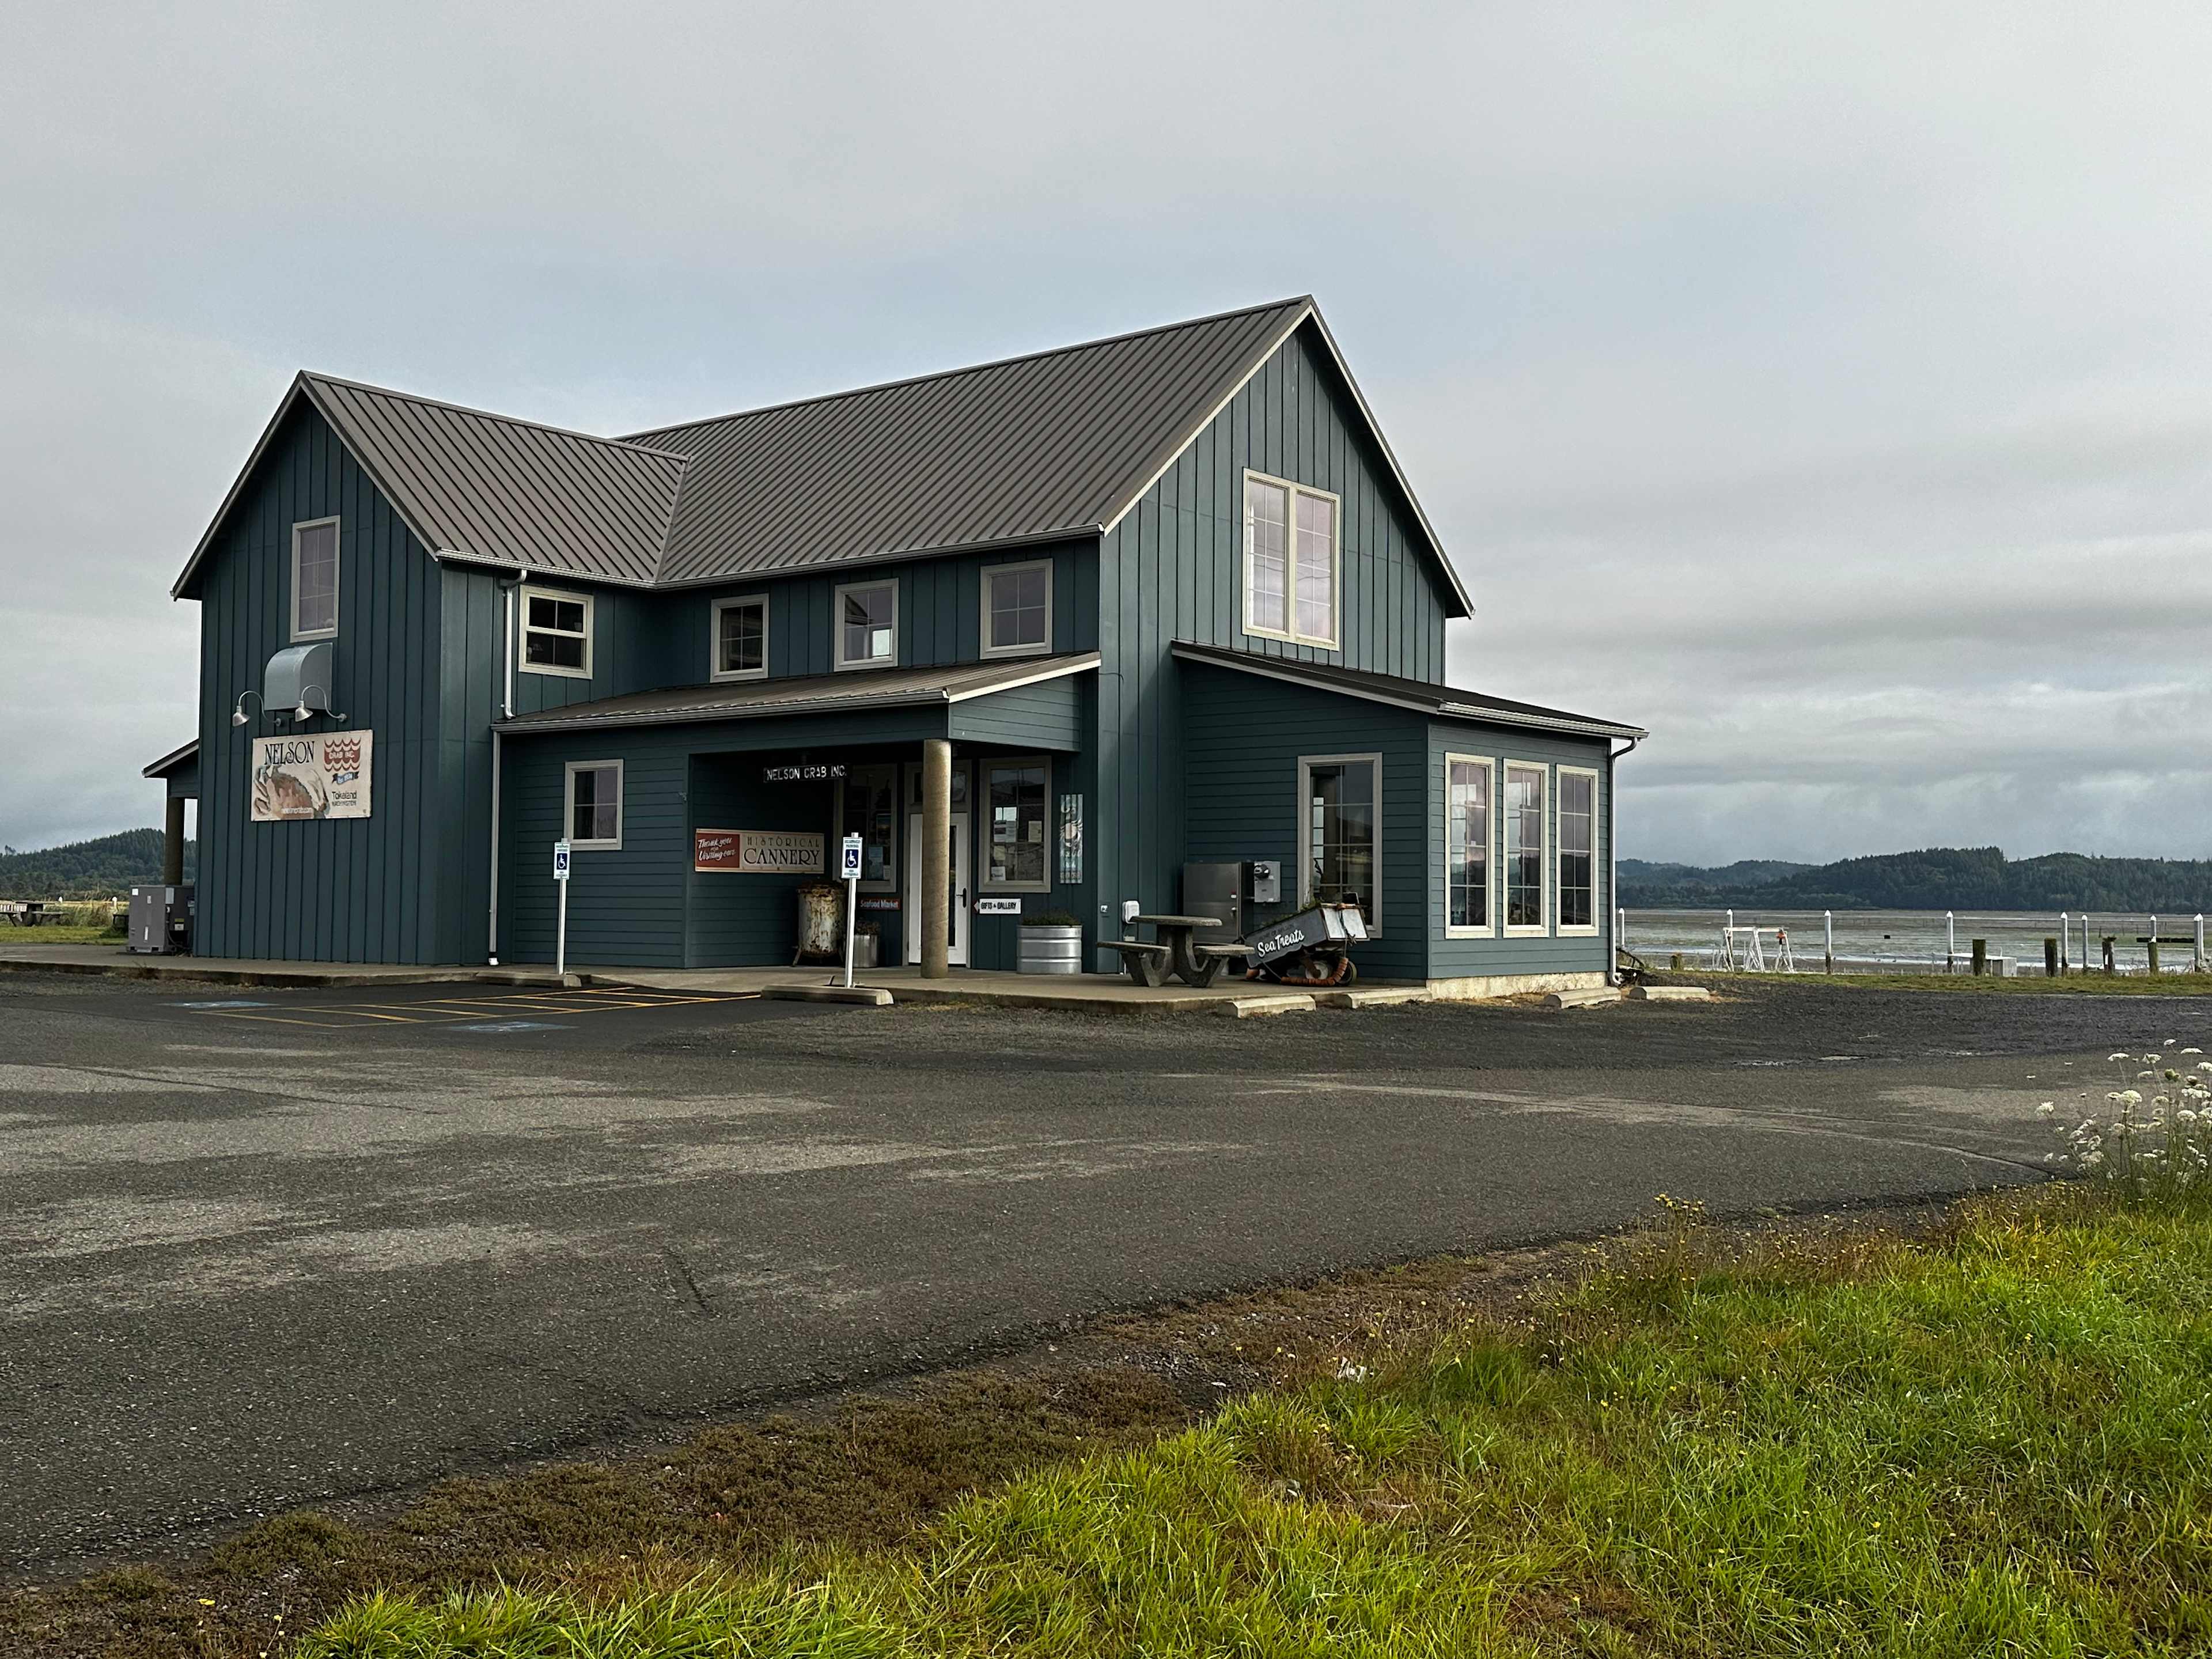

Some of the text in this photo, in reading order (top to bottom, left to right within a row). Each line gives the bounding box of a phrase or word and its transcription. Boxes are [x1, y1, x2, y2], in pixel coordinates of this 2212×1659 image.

[264, 741, 315, 765] NELSON
[767, 768, 800, 781] NELSON
[804, 766, 827, 778] CRAB
[698, 838, 719, 849] Thank
[747, 836, 820, 848] HISTORICAL
[744, 847, 820, 865] CANNERY
[1257, 941, 1277, 957] Sea
[1275, 929, 1305, 950] Treats
